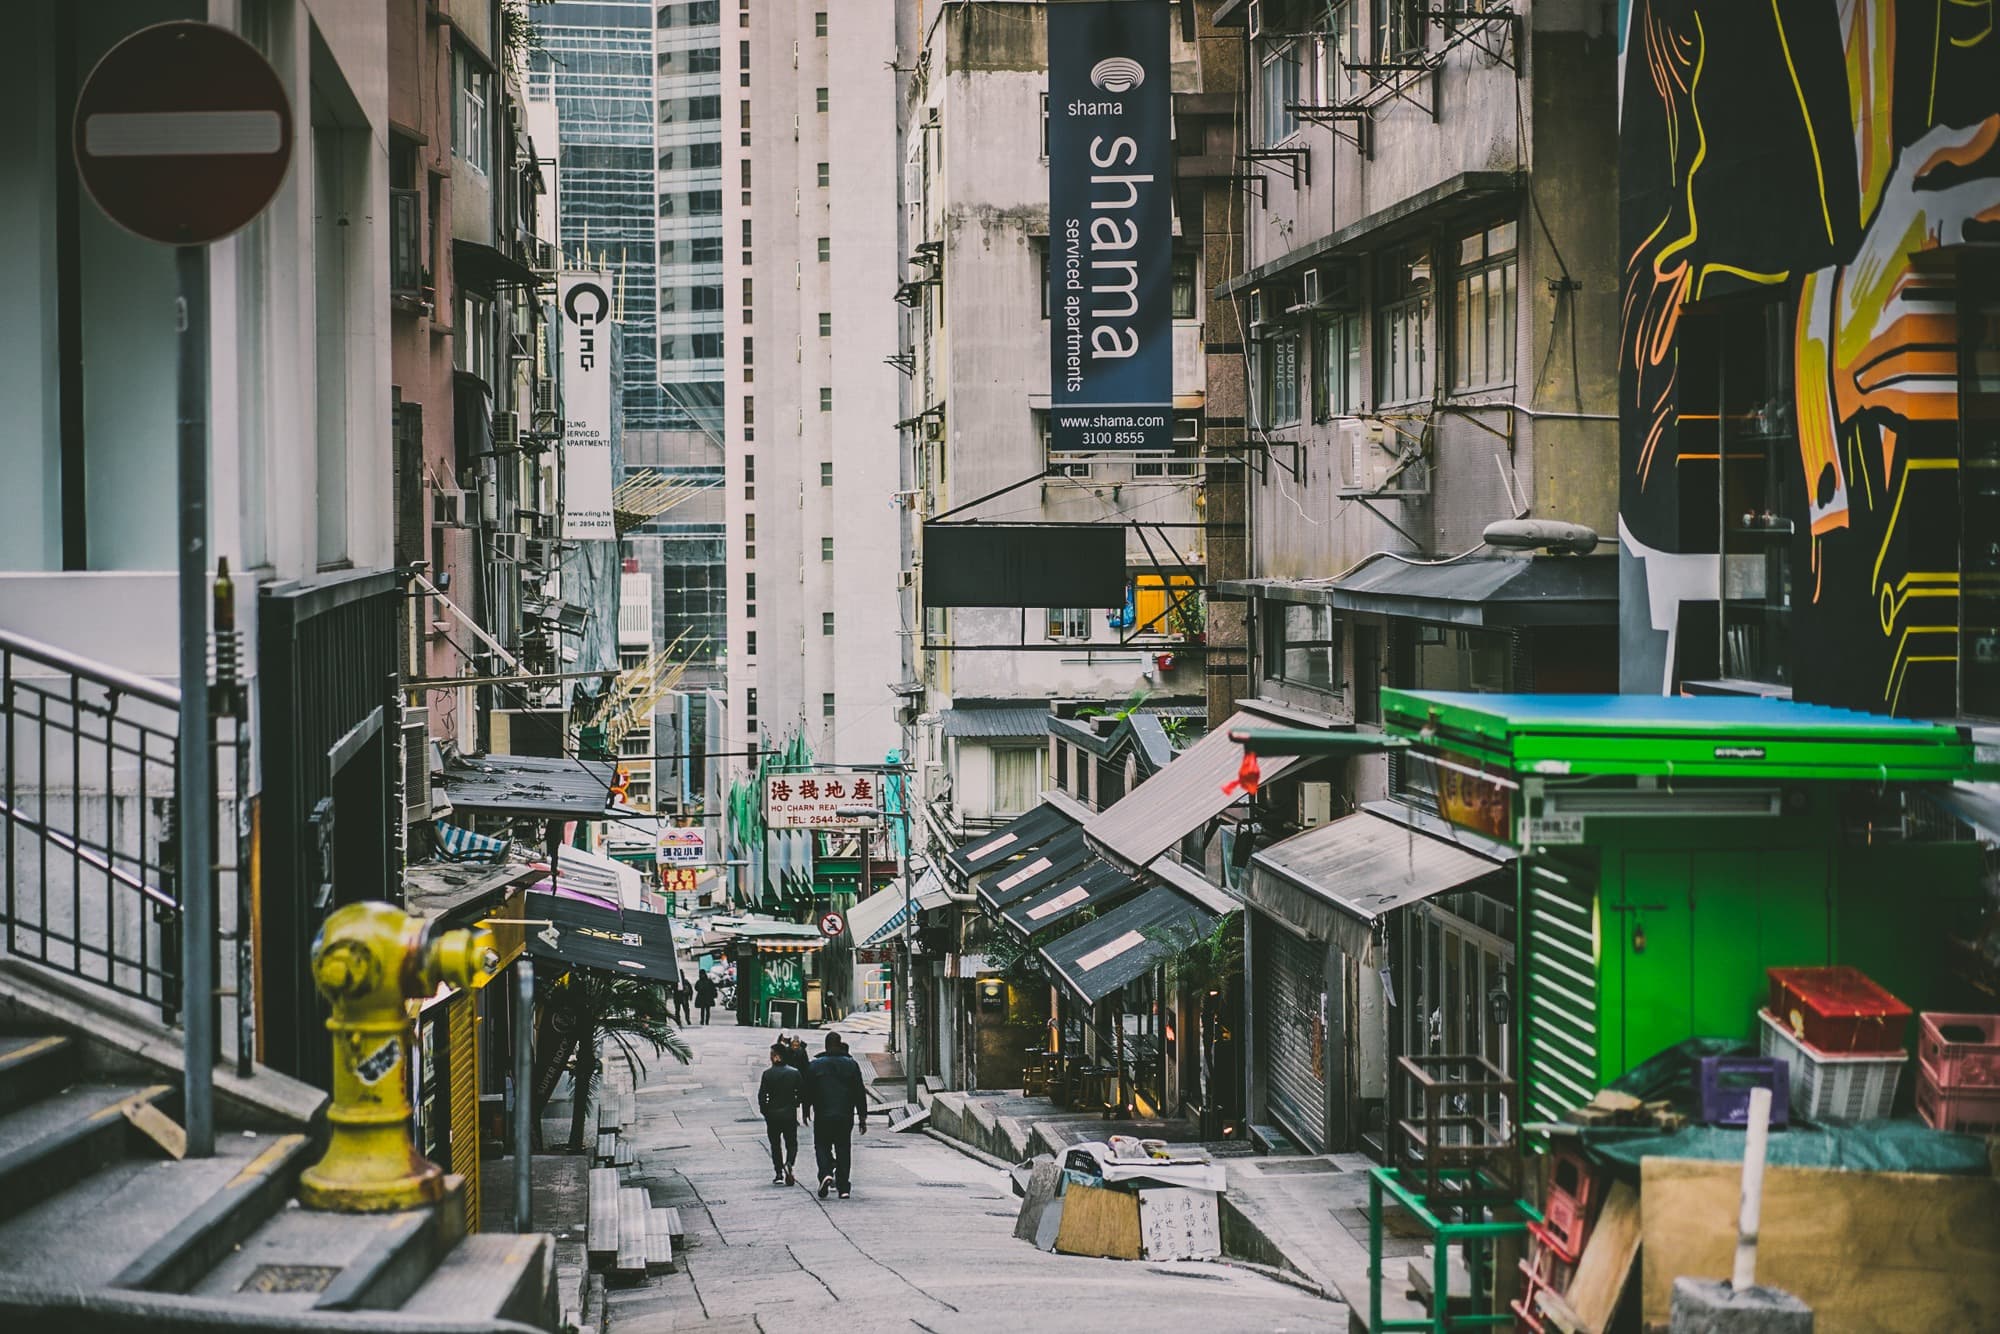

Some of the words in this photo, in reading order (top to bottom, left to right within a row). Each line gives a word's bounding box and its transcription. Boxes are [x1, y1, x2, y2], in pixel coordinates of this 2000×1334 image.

[1067, 99, 1124, 116] shama
[1089, 135, 1155, 359] shama
[1066, 218, 1081, 291] serviced
[1065, 295, 1084, 393] apartments
[1060, 414, 1164, 428] www.shama.com
[1082, 432, 1112, 444] 3100
[1114, 431, 1145, 444] 8555
[567, 510, 611, 518] www.cling.hk
[787, 804, 815, 812] CHARN
[810, 815, 834, 823] 2544
